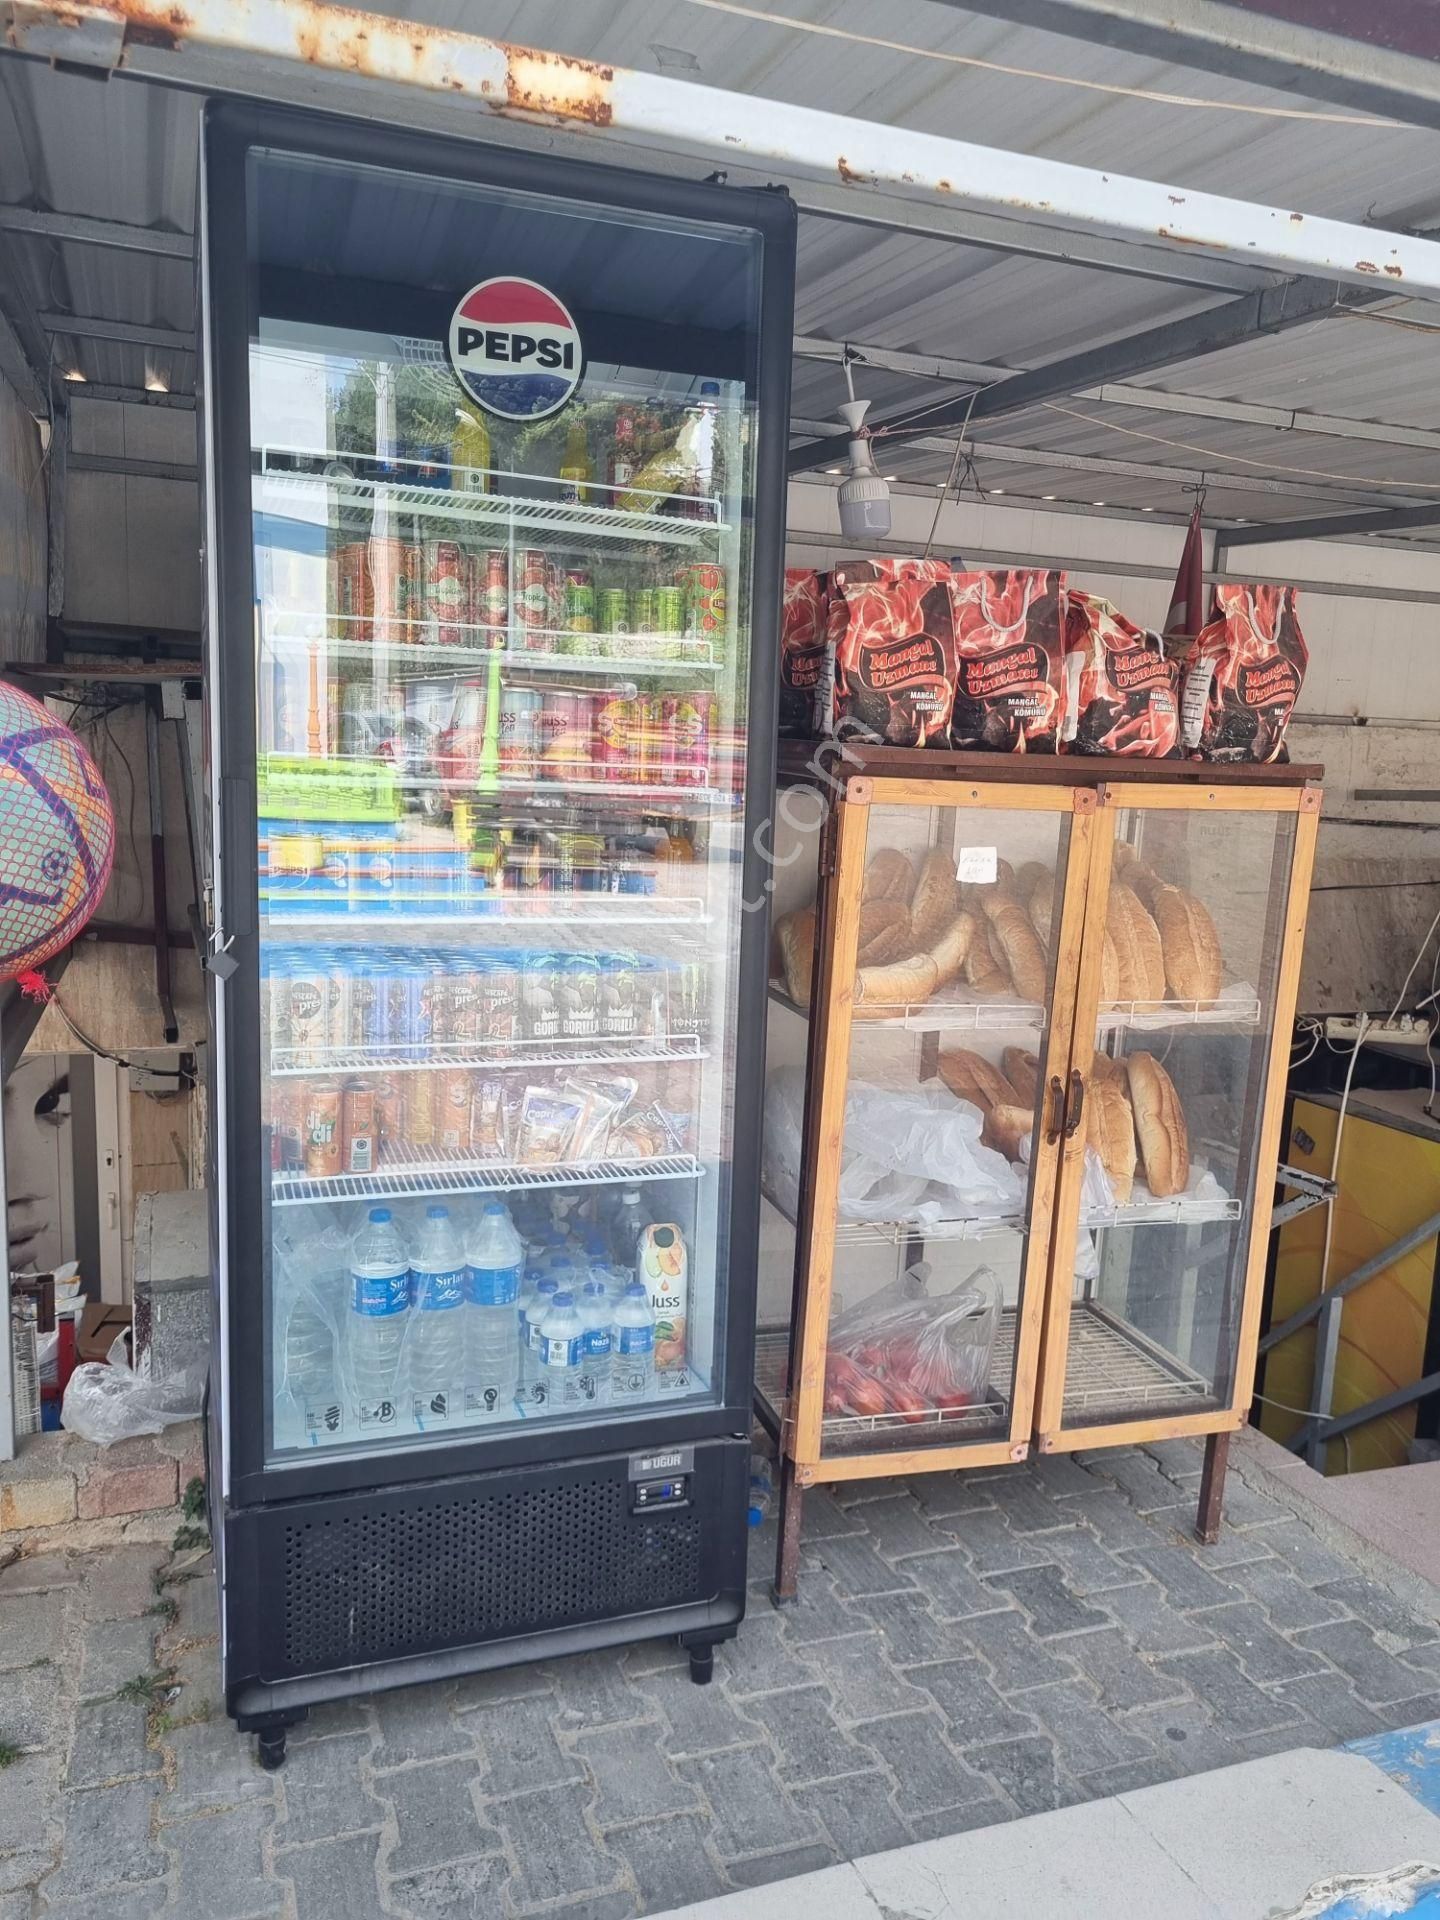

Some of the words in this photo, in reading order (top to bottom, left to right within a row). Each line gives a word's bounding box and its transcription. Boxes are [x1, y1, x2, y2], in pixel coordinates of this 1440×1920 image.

[458, 326, 574, 370] PEPSI
[869, 639, 935, 671] Mangal
[966, 646, 1038, 678] Mangal
[1114, 651, 1161, 671] Mang
[910, 691, 937, 700] MANGAL
[1007, 697, 1039, 706] MANGAL
[563, 1019, 599, 1035] GORILLA
[602, 1016, 638, 1032] GORILLA
[312, 1125, 332, 1144] di
[652, 1294, 681, 1308] Juss
